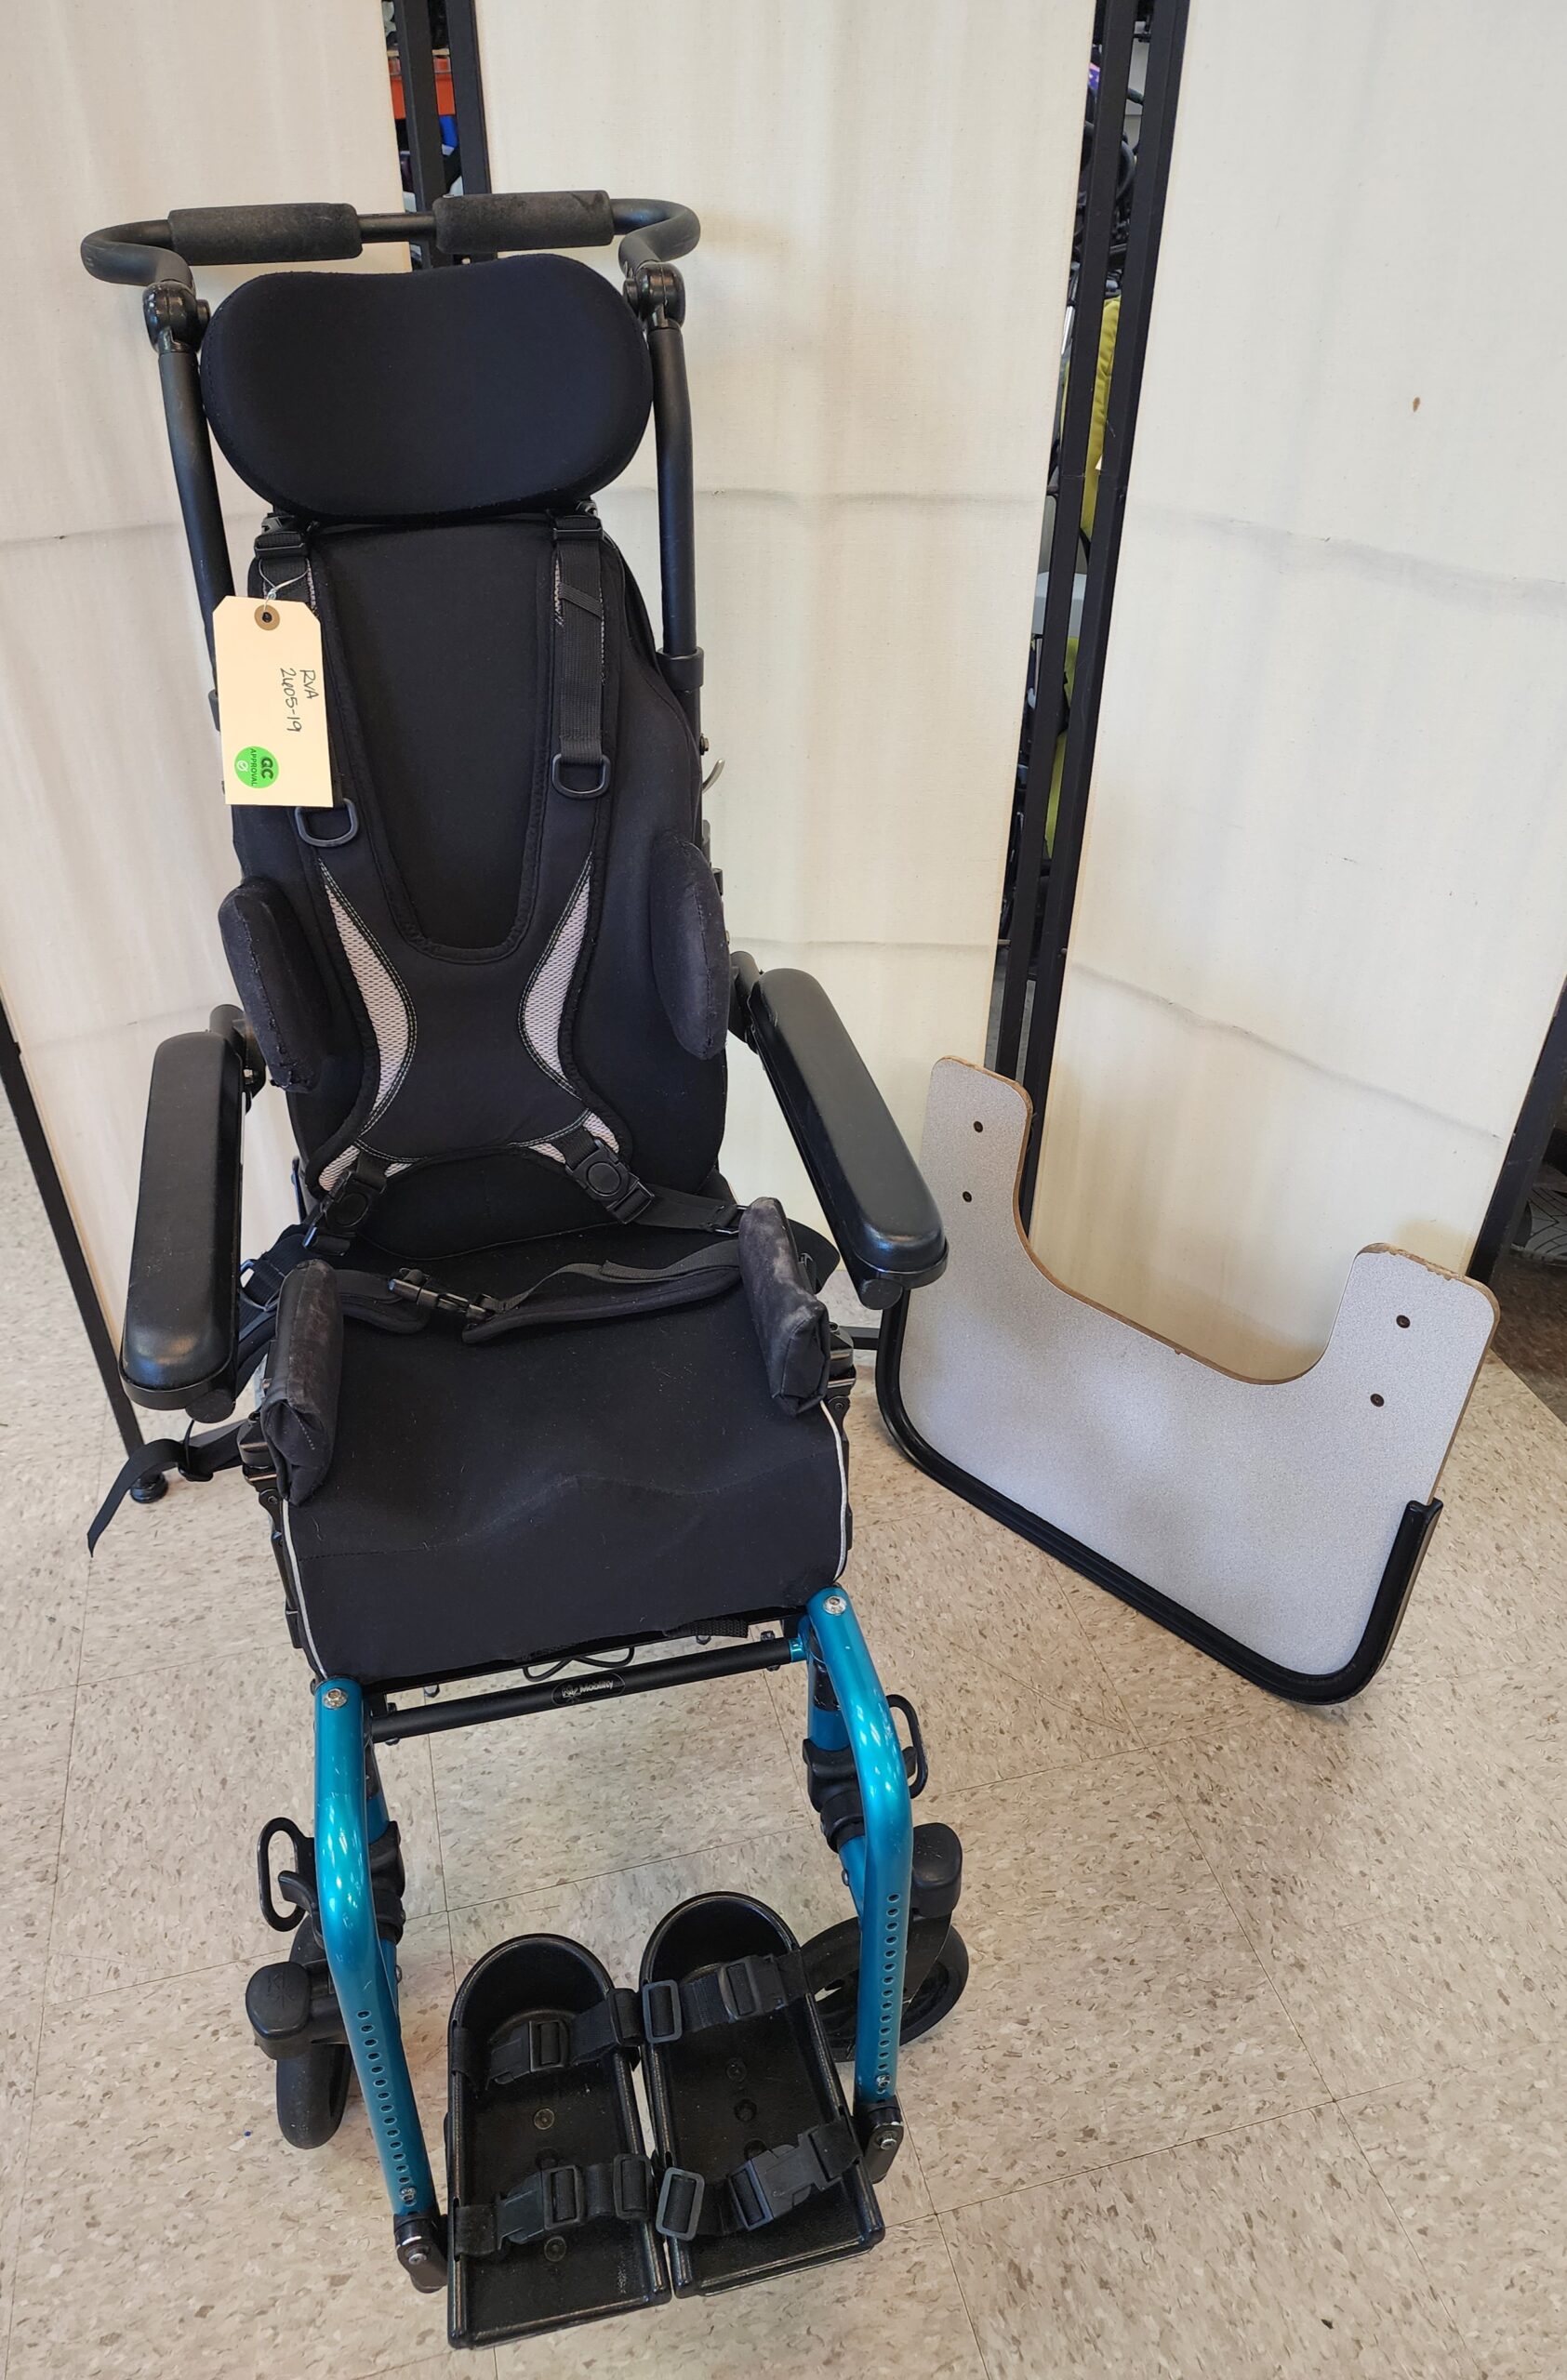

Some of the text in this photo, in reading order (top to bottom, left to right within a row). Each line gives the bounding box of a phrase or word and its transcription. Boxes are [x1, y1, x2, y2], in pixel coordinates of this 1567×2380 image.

[299, 669, 319, 699] RVA
[261, 757, 273, 779] QC
[579, 1680, 614, 1692] Mobility
